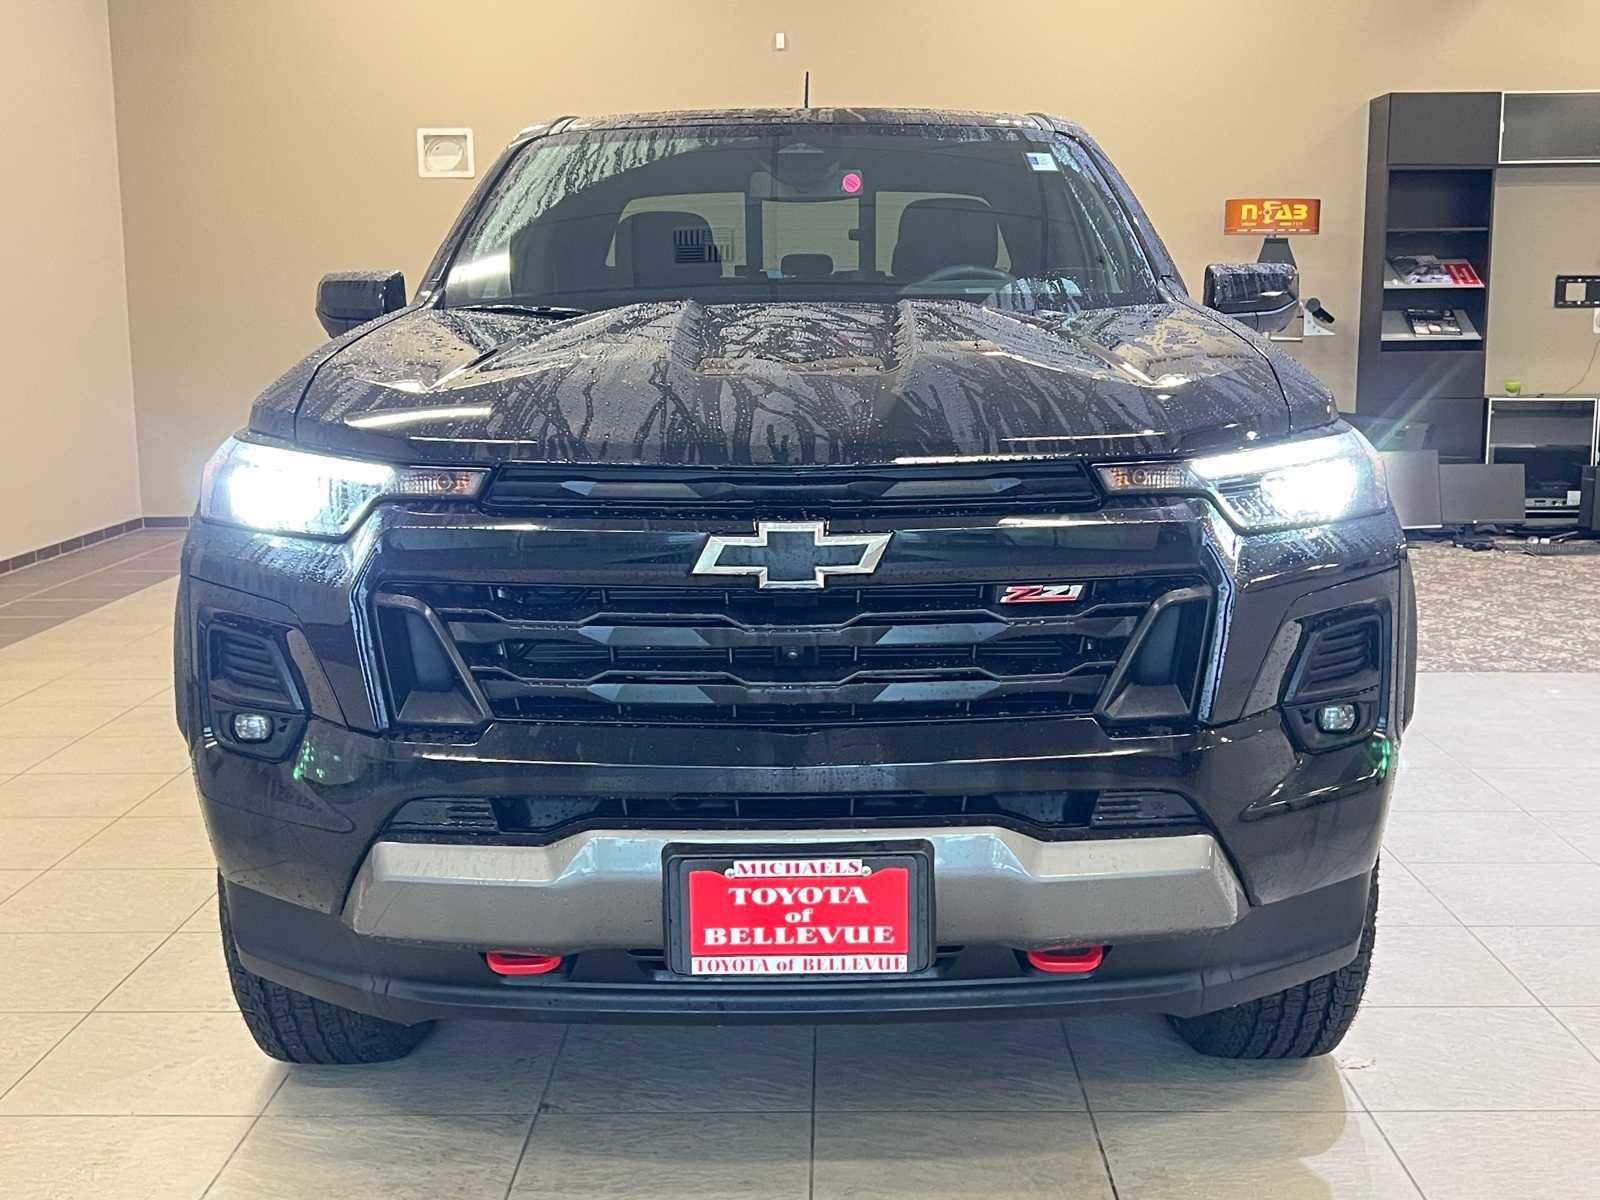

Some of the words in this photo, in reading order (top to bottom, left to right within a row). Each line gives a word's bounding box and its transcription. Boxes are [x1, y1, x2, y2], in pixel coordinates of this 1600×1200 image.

[737, 861, 861, 875] MICHAELS
[728, 886, 869, 905] TOYOTA
[785, 908, 813, 923] of
[703, 926, 895, 946] BELLEVUE
[694, 958, 769, 972] TOYOTA
[776, 957, 795, 972] of
[802, 956, 905, 972] BELLEVUE
